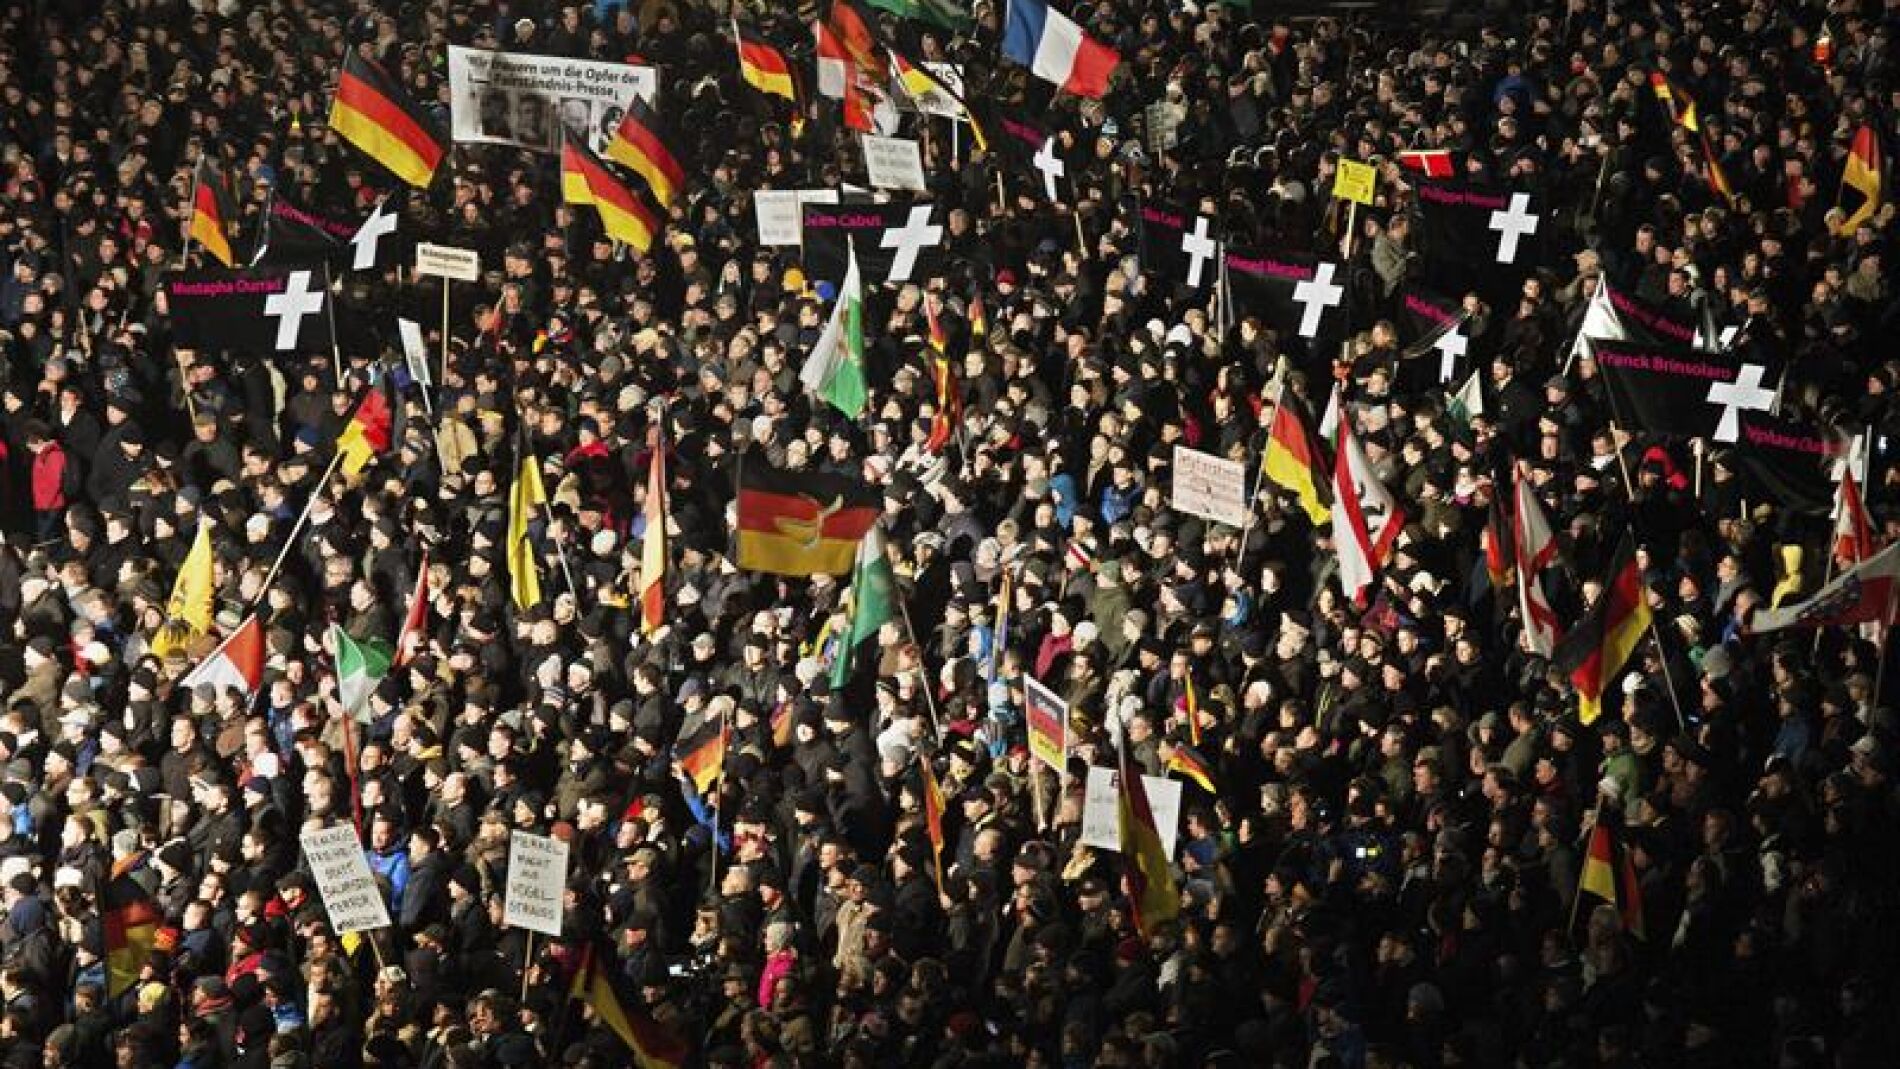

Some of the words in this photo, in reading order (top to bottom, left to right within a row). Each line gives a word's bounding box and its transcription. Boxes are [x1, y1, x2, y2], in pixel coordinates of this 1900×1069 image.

[541, 65, 561, 76] um
[564, 64, 583, 79] die
[586, 67, 618, 85] Opfer
[1597, 351, 1650, 370] Franck
[1653, 356, 1733, 379] Brinsolaro
